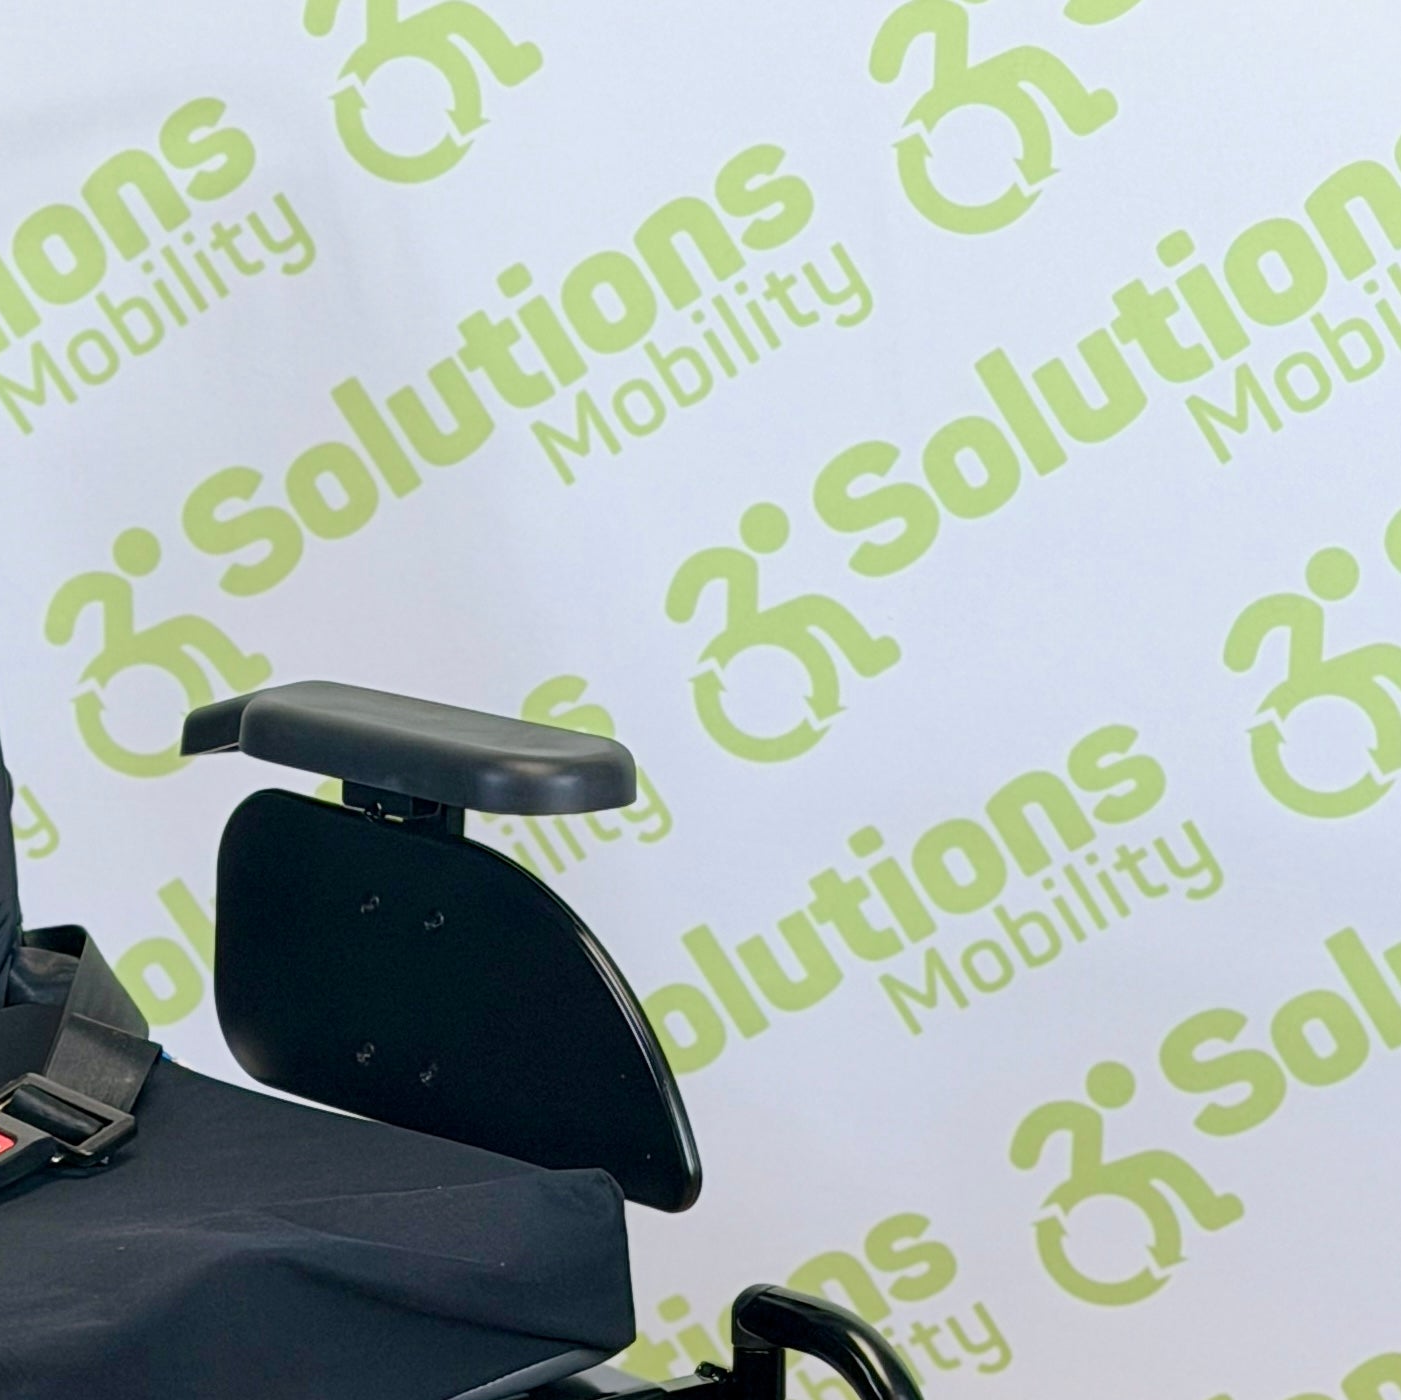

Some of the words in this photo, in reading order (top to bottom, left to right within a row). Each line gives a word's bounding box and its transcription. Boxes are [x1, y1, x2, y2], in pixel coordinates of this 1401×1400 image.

[181, 144, 815, 598] Solutions
[531, 242, 874, 486] Mobility
[811, 133, 1401, 579] Solution
[640, 723, 1167, 1077] olutions
[878, 820, 1224, 1037] Mobility
